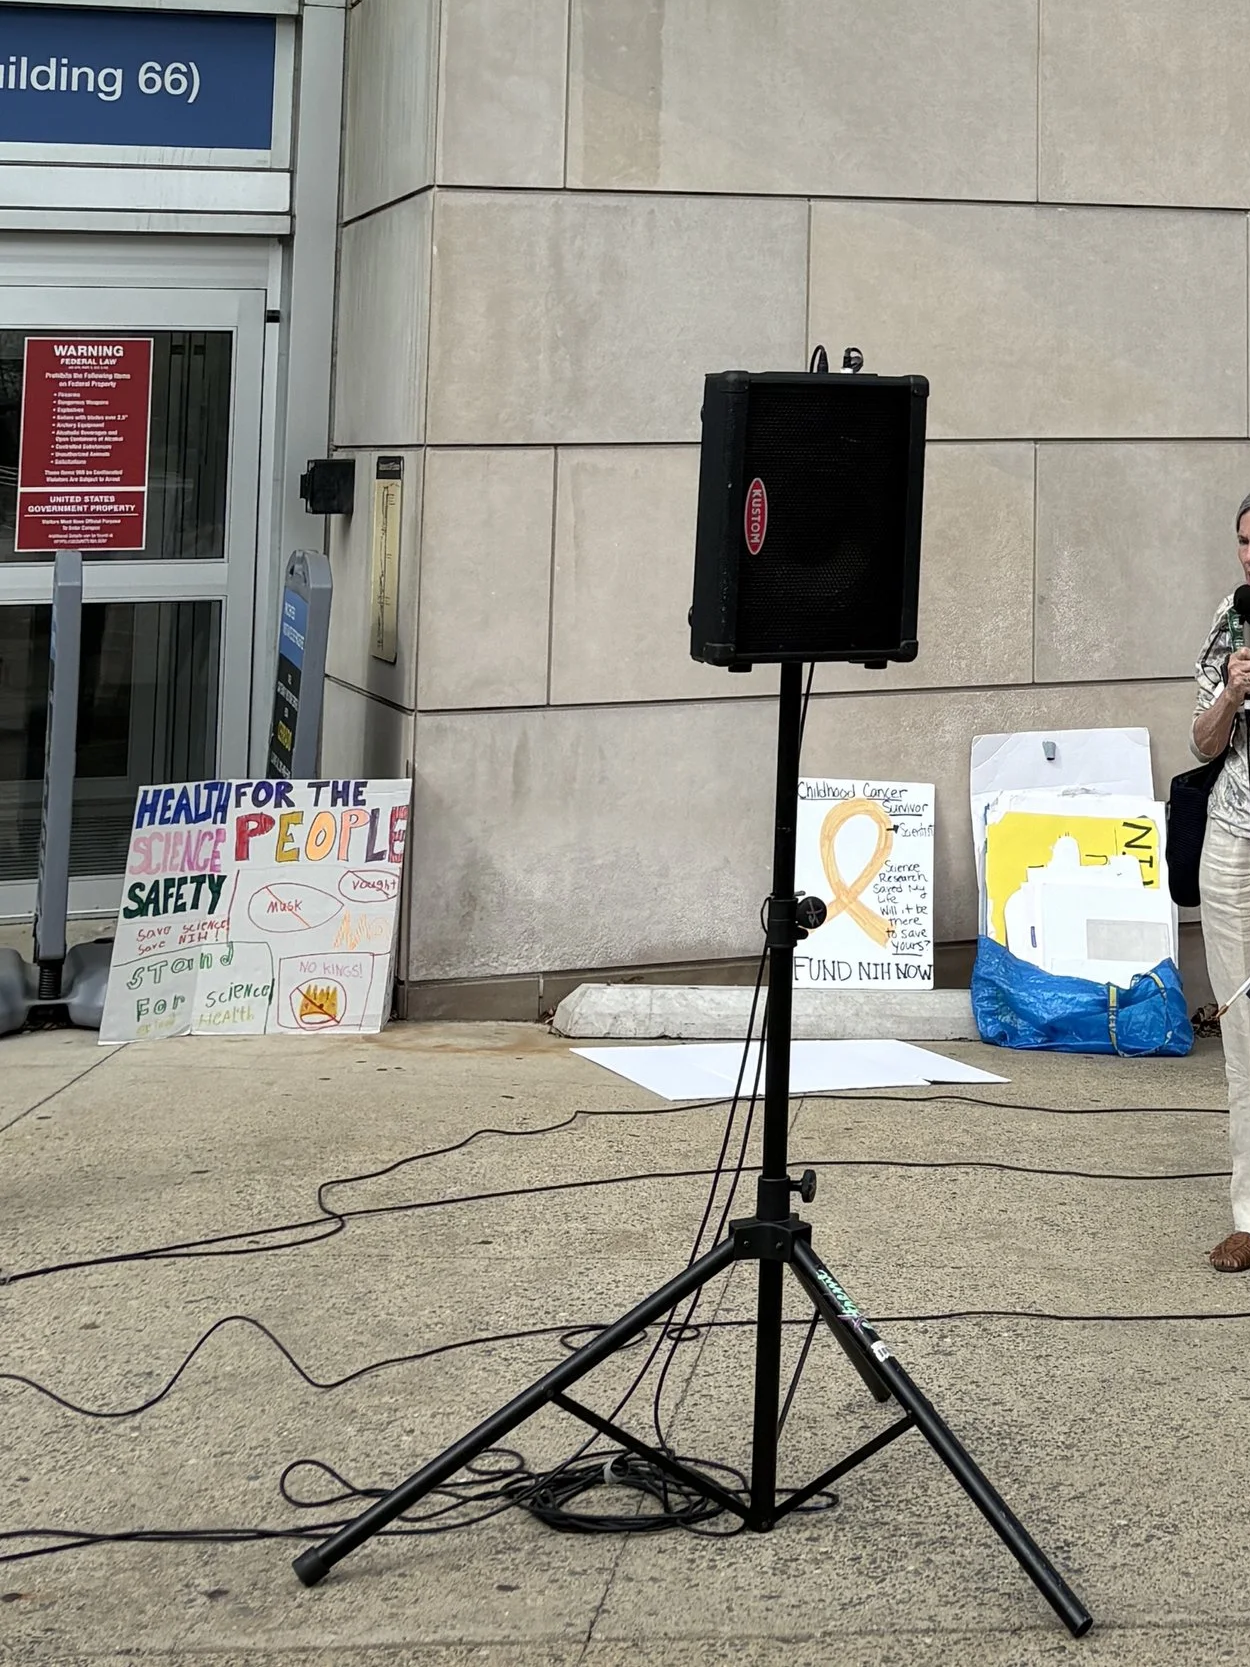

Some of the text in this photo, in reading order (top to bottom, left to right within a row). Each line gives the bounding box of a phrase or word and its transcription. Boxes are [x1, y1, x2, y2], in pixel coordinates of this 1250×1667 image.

[138, 62, 200, 103] 66)
[54, 345, 124, 356] WARNING
[28, 504, 136, 513] GOVERNMENT PROPERTY
[750, 489, 762, 543] KUSTOM
[798, 781, 908, 799] Childhood Cancer
[135, 780, 368, 829] HEALTH FOR THE
[882, 799, 928, 814] Survivor
[235, 804, 410, 863] PEOPLE
[128, 828, 227, 875] SCIENCE
[884, 860, 920, 872] Science
[879, 872, 928, 883] Research
[123, 874, 228, 919] SAFETY
[901, 929, 927, 939] save
[891, 939, 931, 954] yours?
[299, 961, 363, 979] NO KINGS!
[793, 956, 933, 981] FUND NIH NOW
